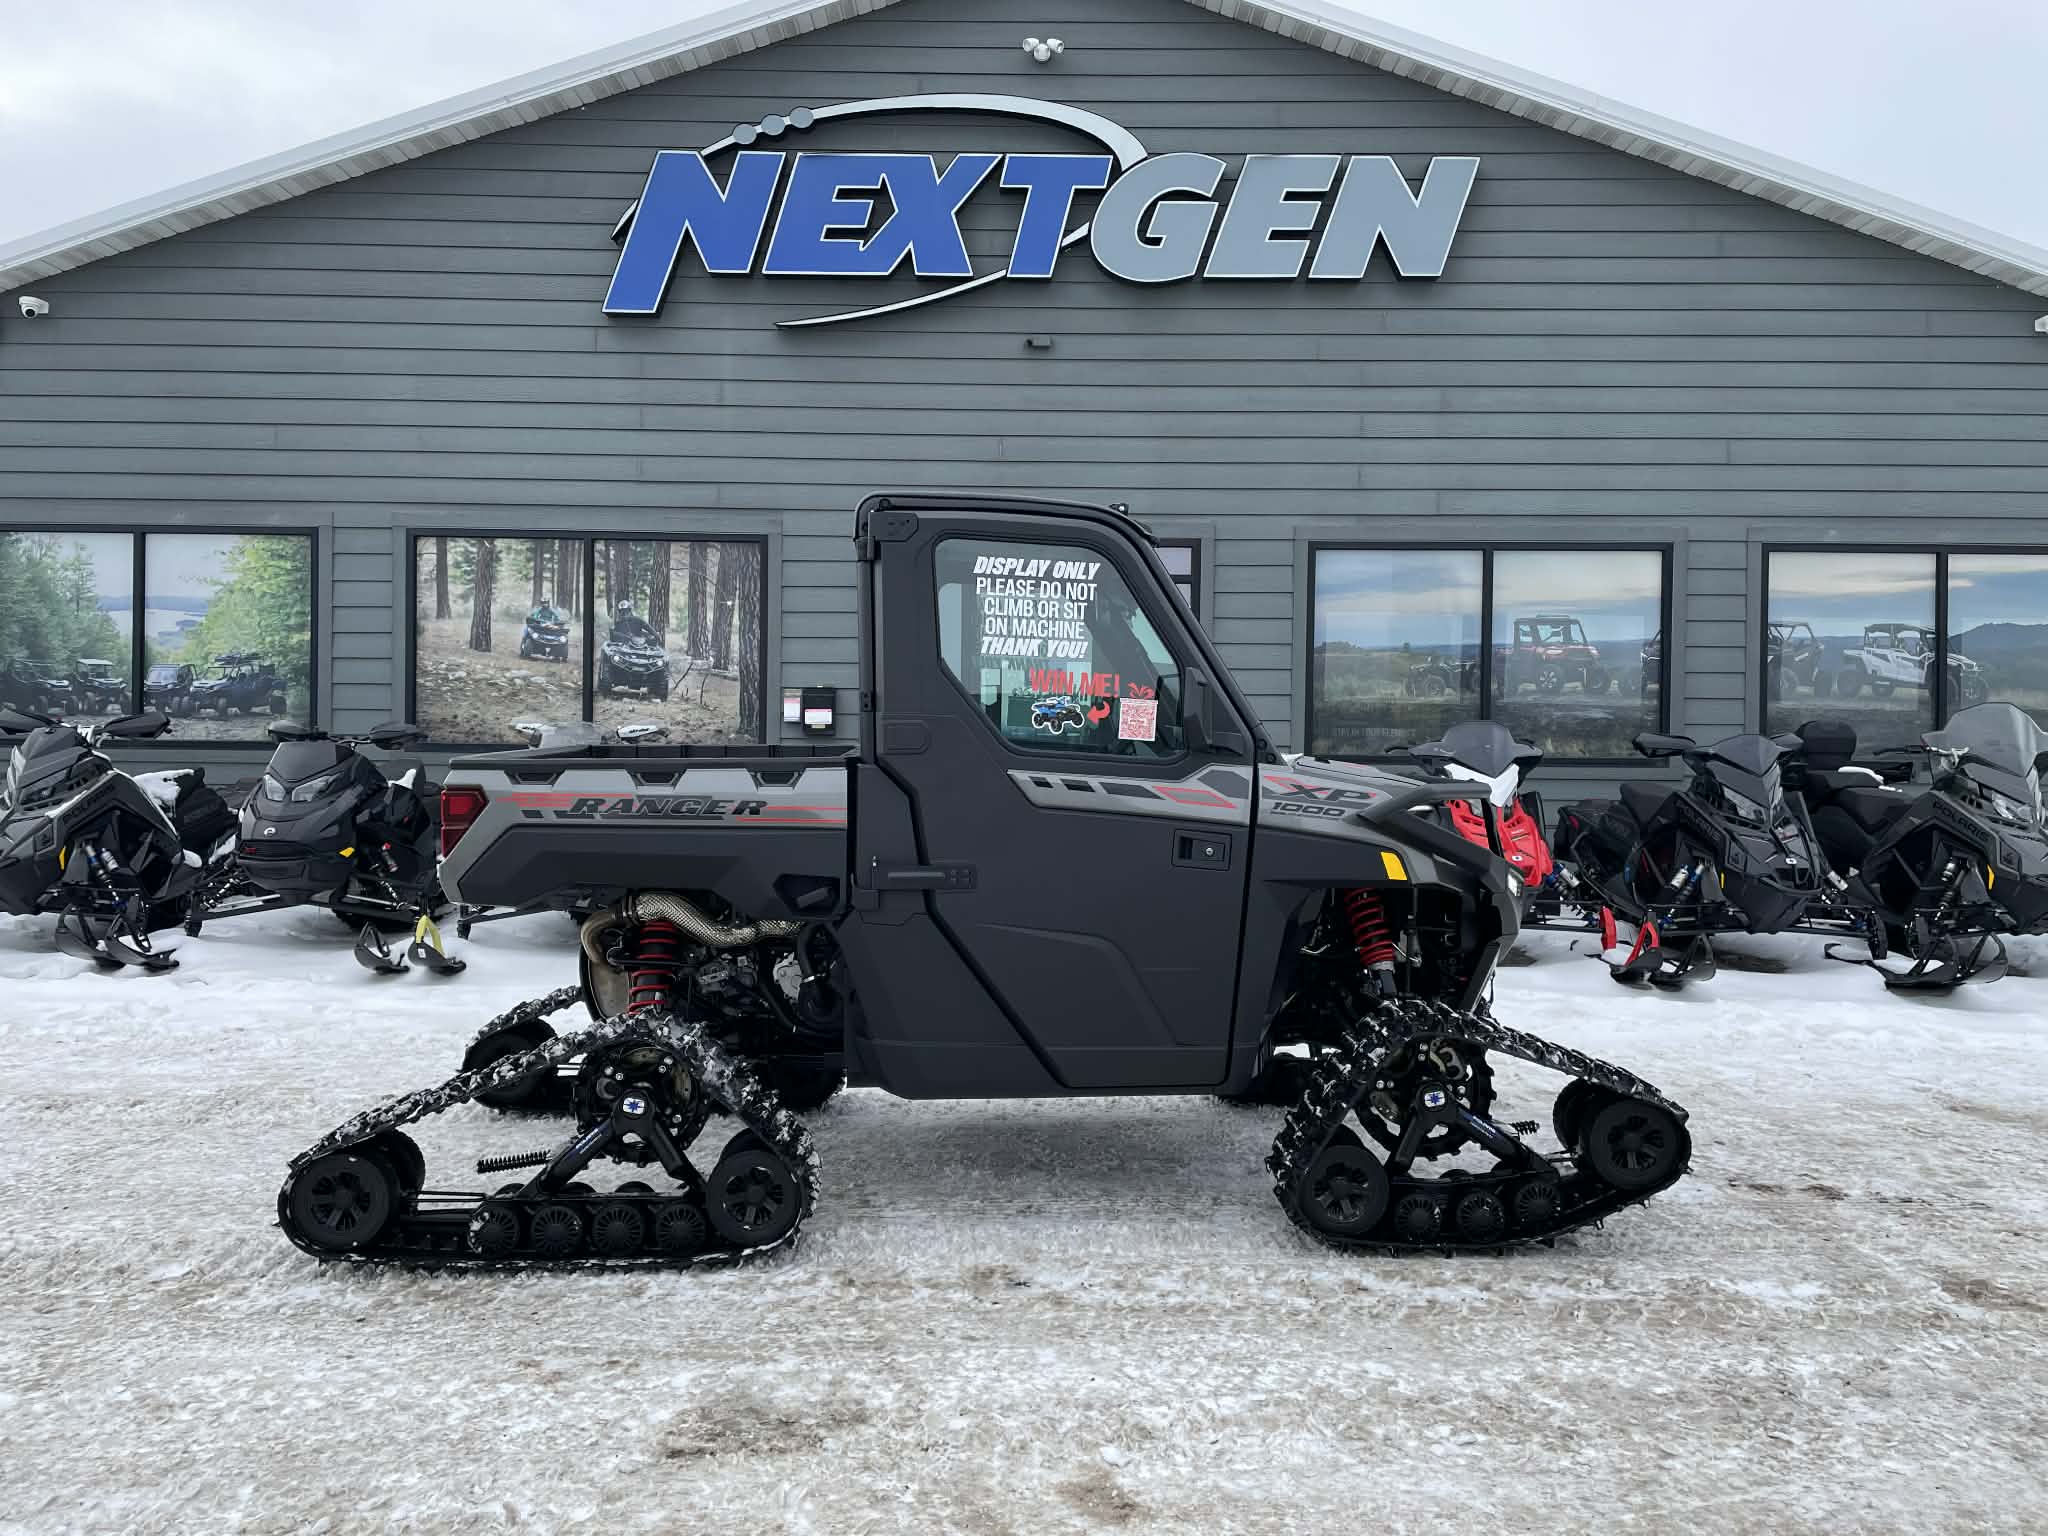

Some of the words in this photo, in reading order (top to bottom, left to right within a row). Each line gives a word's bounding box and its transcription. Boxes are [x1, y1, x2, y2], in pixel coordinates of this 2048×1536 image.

[602, 150, 1481, 317] NEXTGEN
[973, 556, 1050, 577] DISPLAY
[1052, 560, 1100, 580] ONLY
[976, 577, 1034, 597] PLEASE
[1040, 581, 1061, 599] DO
[1066, 583, 1097, 600] NOT
[984, 598, 1033, 617] CLIMB
[1037, 601, 1059, 618] OR
[1063, 602, 1087, 620] SIT
[985, 618, 1010, 635] ON
[1013, 619, 1084, 639] MACHINE
[980, 637, 1043, 657] THANK
[1047, 640, 1088, 658] YOU!
[1030, 667, 1074, 694] WIN
[1080, 672, 1120, 698] ME!
[1280, 784, 1371, 802] XP
[567, 798, 768, 816] RANGER
[1272, 802, 1346, 816] 1000
[1936, 800, 1989, 841] POLARIS
